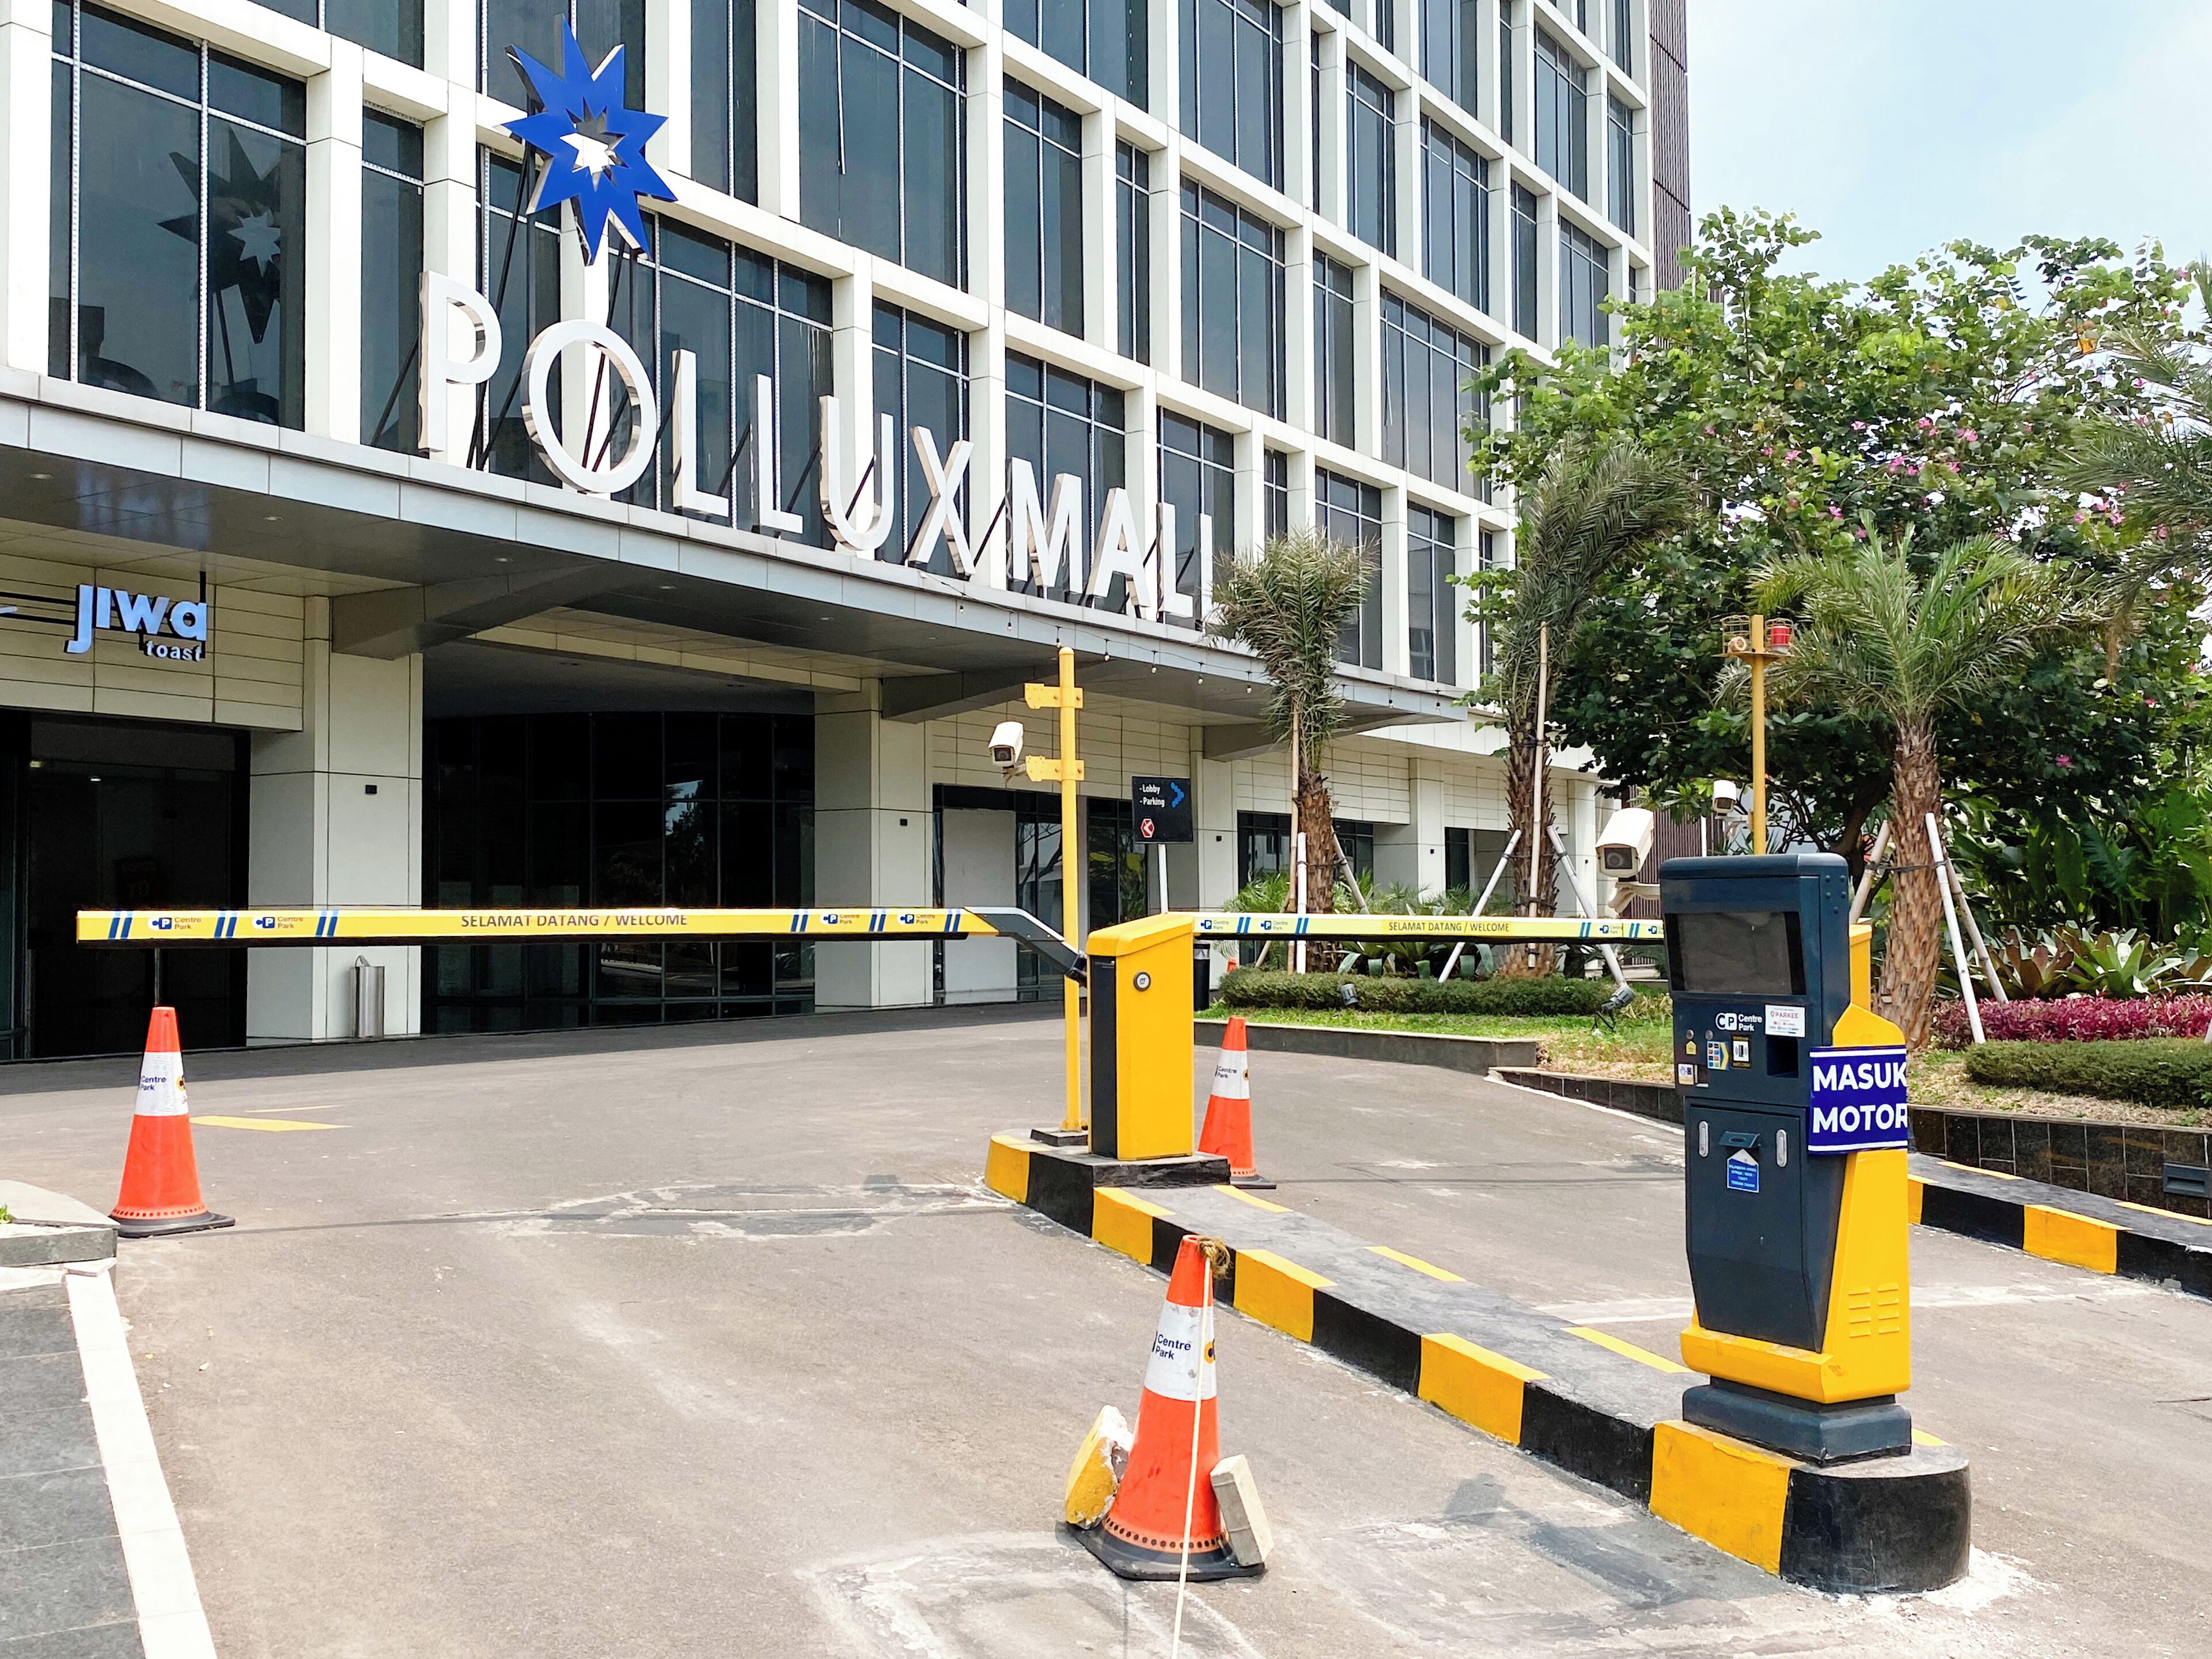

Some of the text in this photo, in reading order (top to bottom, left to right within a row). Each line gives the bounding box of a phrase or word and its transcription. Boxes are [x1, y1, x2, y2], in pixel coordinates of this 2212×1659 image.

[143, 640, 202, 662] toast
[461, 915, 687, 927] SELAMAT DATANG / WELCOME
[1388, 922, 1509, 933] SELAMAT DATANG / WELCOME
[1738, 1014, 1763, 1022] Centre
[1738, 1023, 1755, 1032] Park
[1218, 1066, 1237, 1074] Centre
[142, 1075, 167, 1084] Centre
[1813, 1062, 1908, 1092] MASUK
[1812, 1103, 1908, 1134] MOTOR
[1157, 1334, 1191, 1351] Centre
[1156, 1345, 1175, 1361] Park
